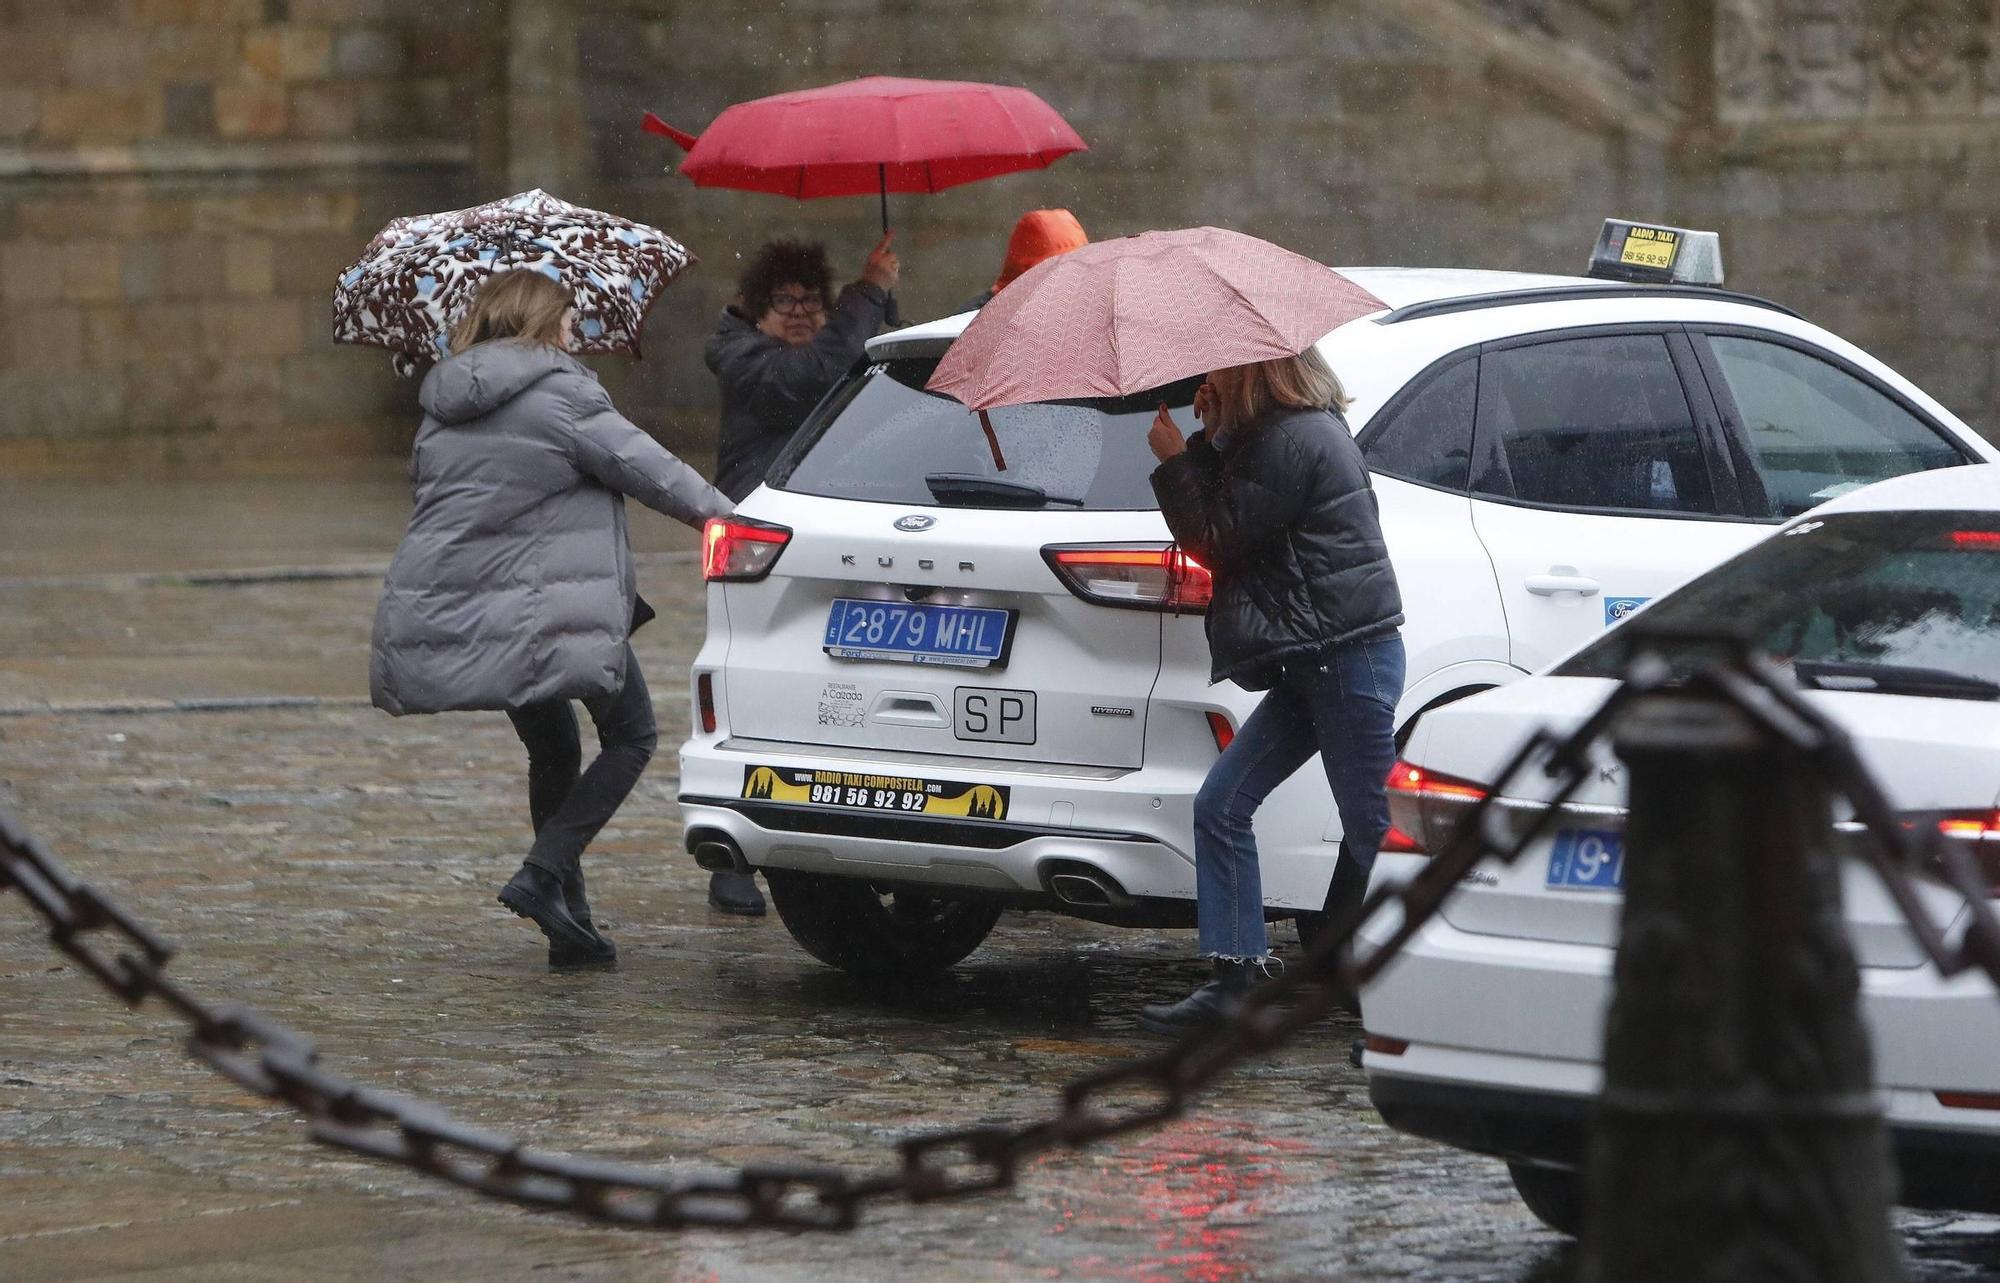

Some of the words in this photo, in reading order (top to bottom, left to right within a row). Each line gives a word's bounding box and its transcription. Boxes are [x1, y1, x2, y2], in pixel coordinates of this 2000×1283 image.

[1631, 227, 1654, 239] RADIO
[1657, 231, 1674, 242] TAXI
[1623, 251, 1634, 261] 981
[1635, 252, 1646, 262] 56
[1646, 254, 1657, 264] 92
[1657, 256, 1668, 266] 92
[901, 517, 928, 527] Ford
[845, 607, 927, 647] 2879
[934, 613, 993, 653] MHL
[822, 689, 828, 698] A
[966, 696, 1023, 734] SP
[1093, 706, 1131, 715] HYBRID
[815, 771, 841, 785] RADIO
[843, 773, 862, 787] TAXI
[864, 775, 923, 791] COMPOSTELA
[812, 785, 841, 803] 981
[846, 788, 868, 806] 56
[874, 790, 896, 808] 92
[902, 792, 924, 810] 92
